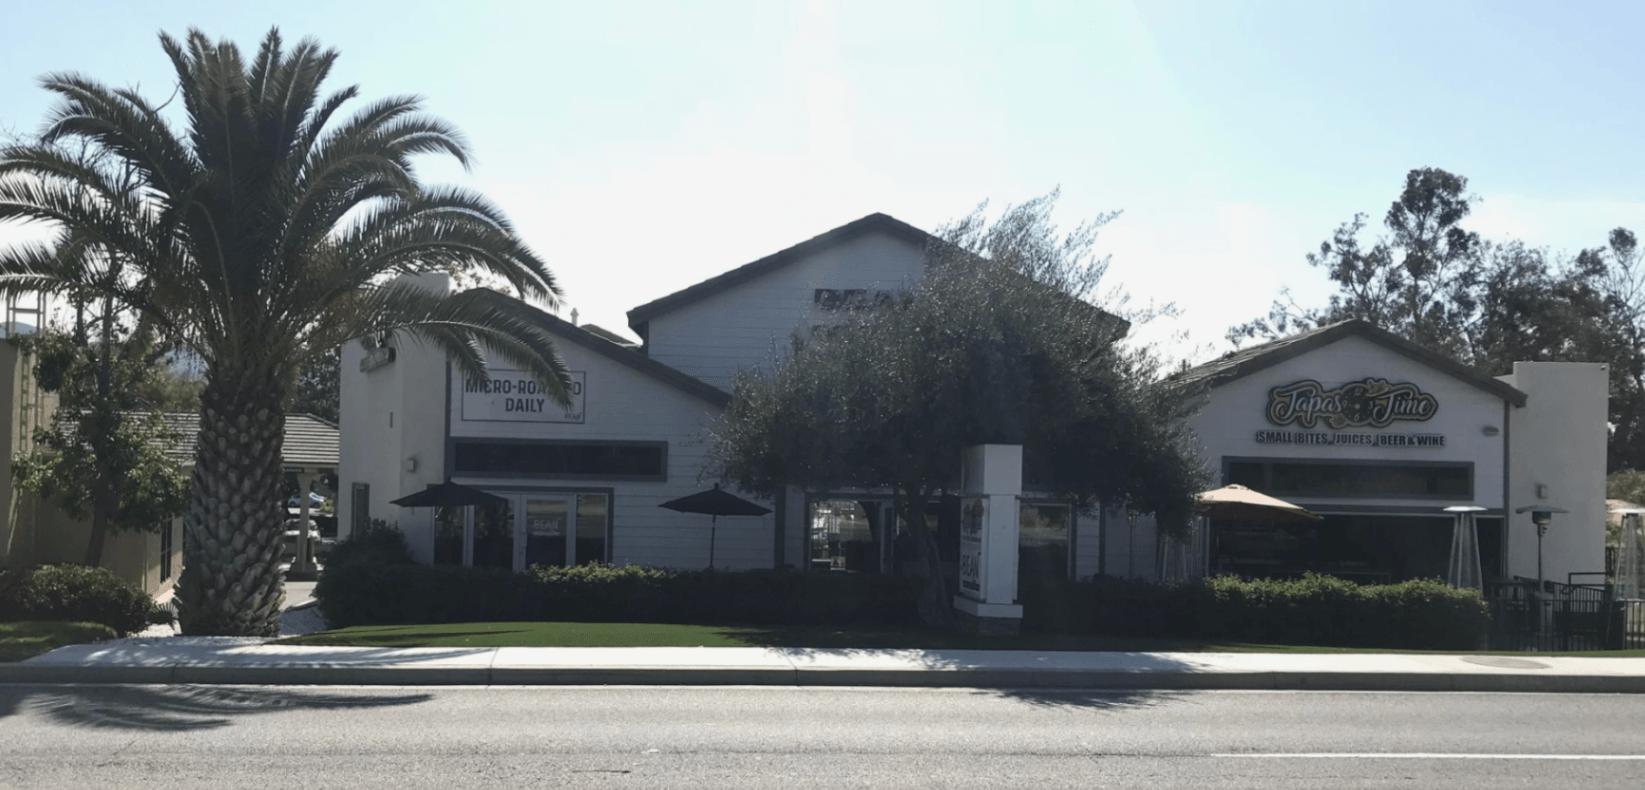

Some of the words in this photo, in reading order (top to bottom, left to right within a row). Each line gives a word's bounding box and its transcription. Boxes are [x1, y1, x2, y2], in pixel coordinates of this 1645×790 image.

[465, 379, 582, 395] MICRO-ROAD
[505, 397, 545, 413] DAILY
[1275, 386, 1343, 422] Tapas
[1373, 388, 1432, 422] Time
[1257, 431, 1293, 444] SMALL
[1380, 434, 1407, 447] BEER
[1407, 435, 1416, 447] &
[1417, 435, 1446, 447] WINE
[533, 517, 562, 531] BEAN
